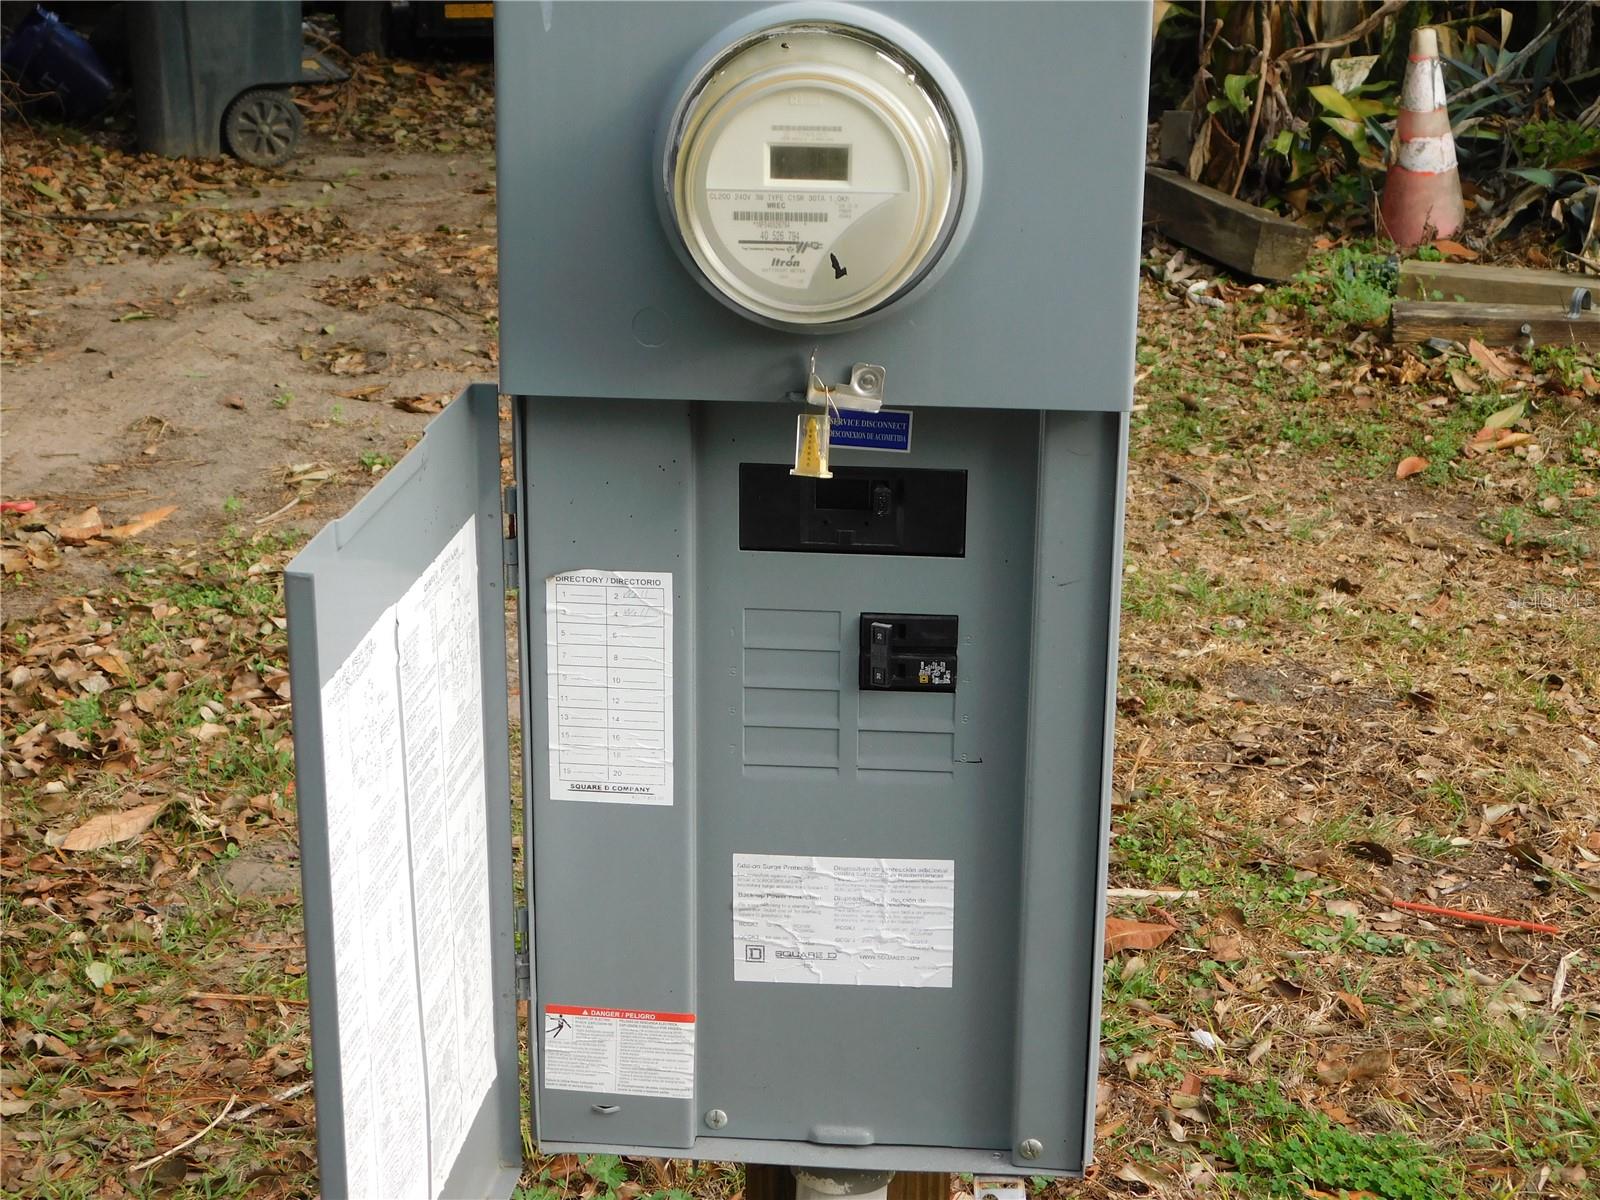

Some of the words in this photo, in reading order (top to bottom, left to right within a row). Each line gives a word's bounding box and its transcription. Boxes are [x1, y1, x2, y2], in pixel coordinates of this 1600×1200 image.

[771, 255, 801, 267] Itron
[829, 417, 860, 427] SERVICE
[861, 419, 907, 430] DISCONNECT
[555, 575, 604, 584] DIRECTORY
[610, 577, 661, 586] DIRECTORIO
[613, 592, 619, 600] 2
[570, 783, 602, 791] SQUARE
[611, 784, 651, 793] COMPANY
[775, 950, 824, 960] SQUARE
[590, 1009, 620, 1018] DANGER
[625, 1012, 656, 1020] PELIGRO
